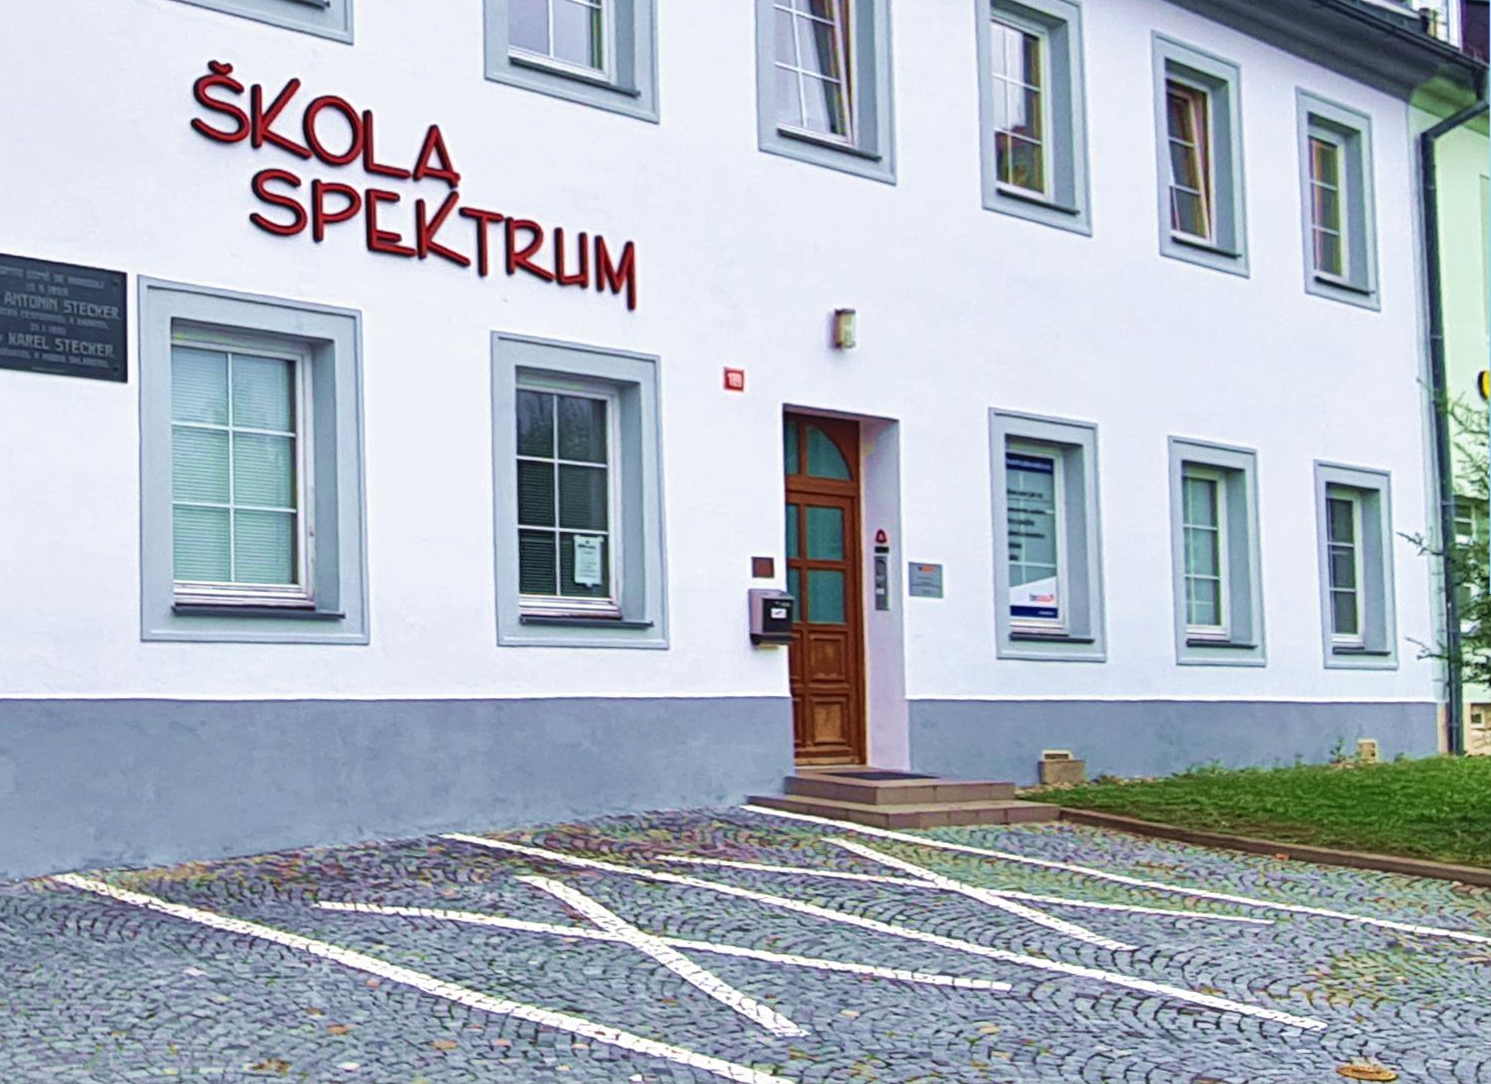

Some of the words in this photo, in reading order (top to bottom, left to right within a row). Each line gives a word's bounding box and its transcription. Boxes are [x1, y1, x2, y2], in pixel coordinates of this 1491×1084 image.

[190, 59, 462, 188] ŠKOLA
[249, 168, 637, 311] SPEKTRUM
[8, 331, 51, 351] KAREL
[55, 337, 115, 357] STECKER
[64, 300, 121, 320] STECKER
